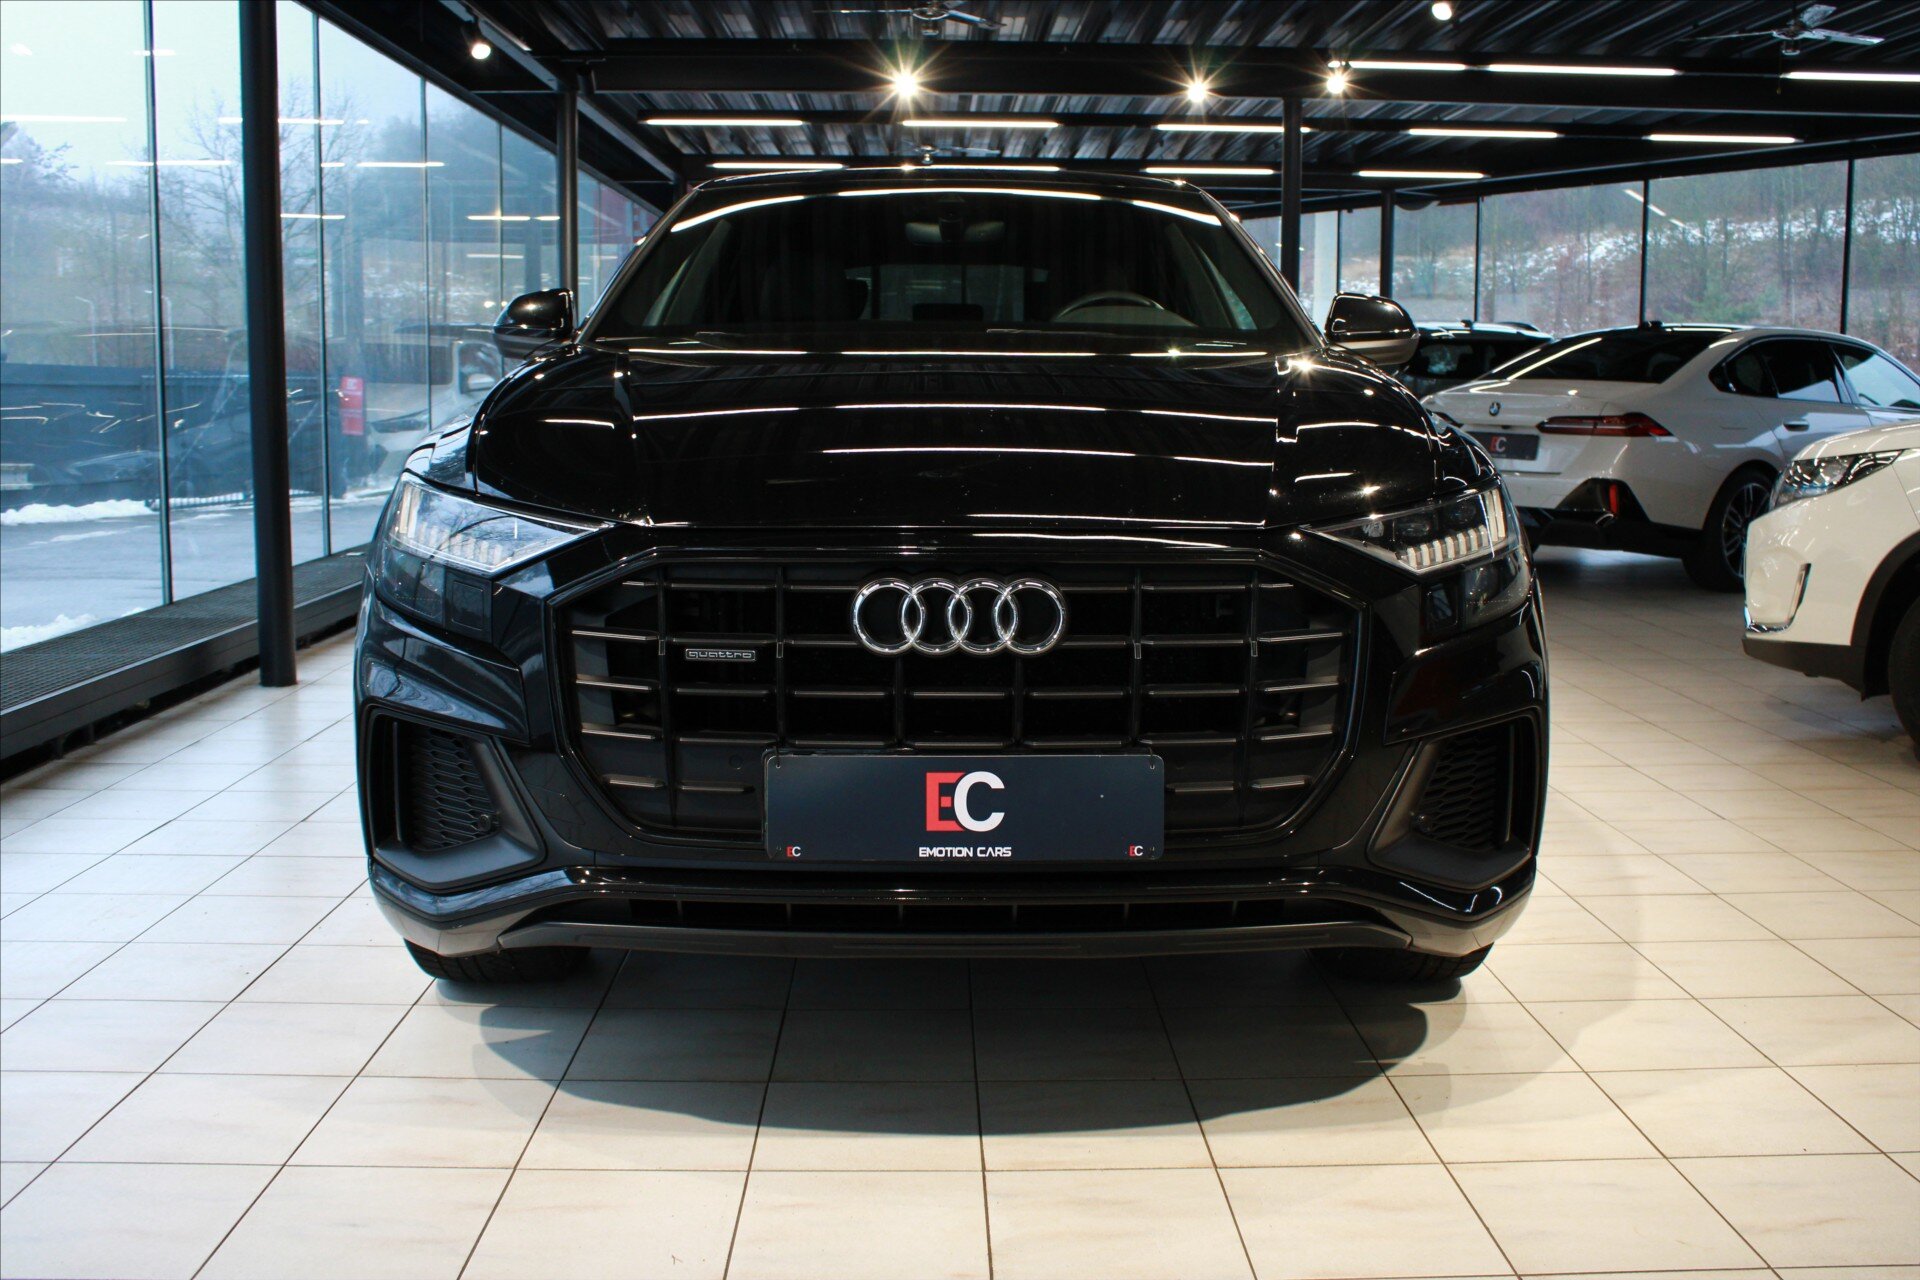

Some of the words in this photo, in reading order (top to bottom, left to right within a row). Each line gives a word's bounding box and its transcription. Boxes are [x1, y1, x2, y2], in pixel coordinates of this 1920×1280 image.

[688, 651, 752, 659] quattro
[926, 771, 1005, 832] EC
[918, 846, 973, 857] EMOTION
[976, 846, 1012, 857] CARS
